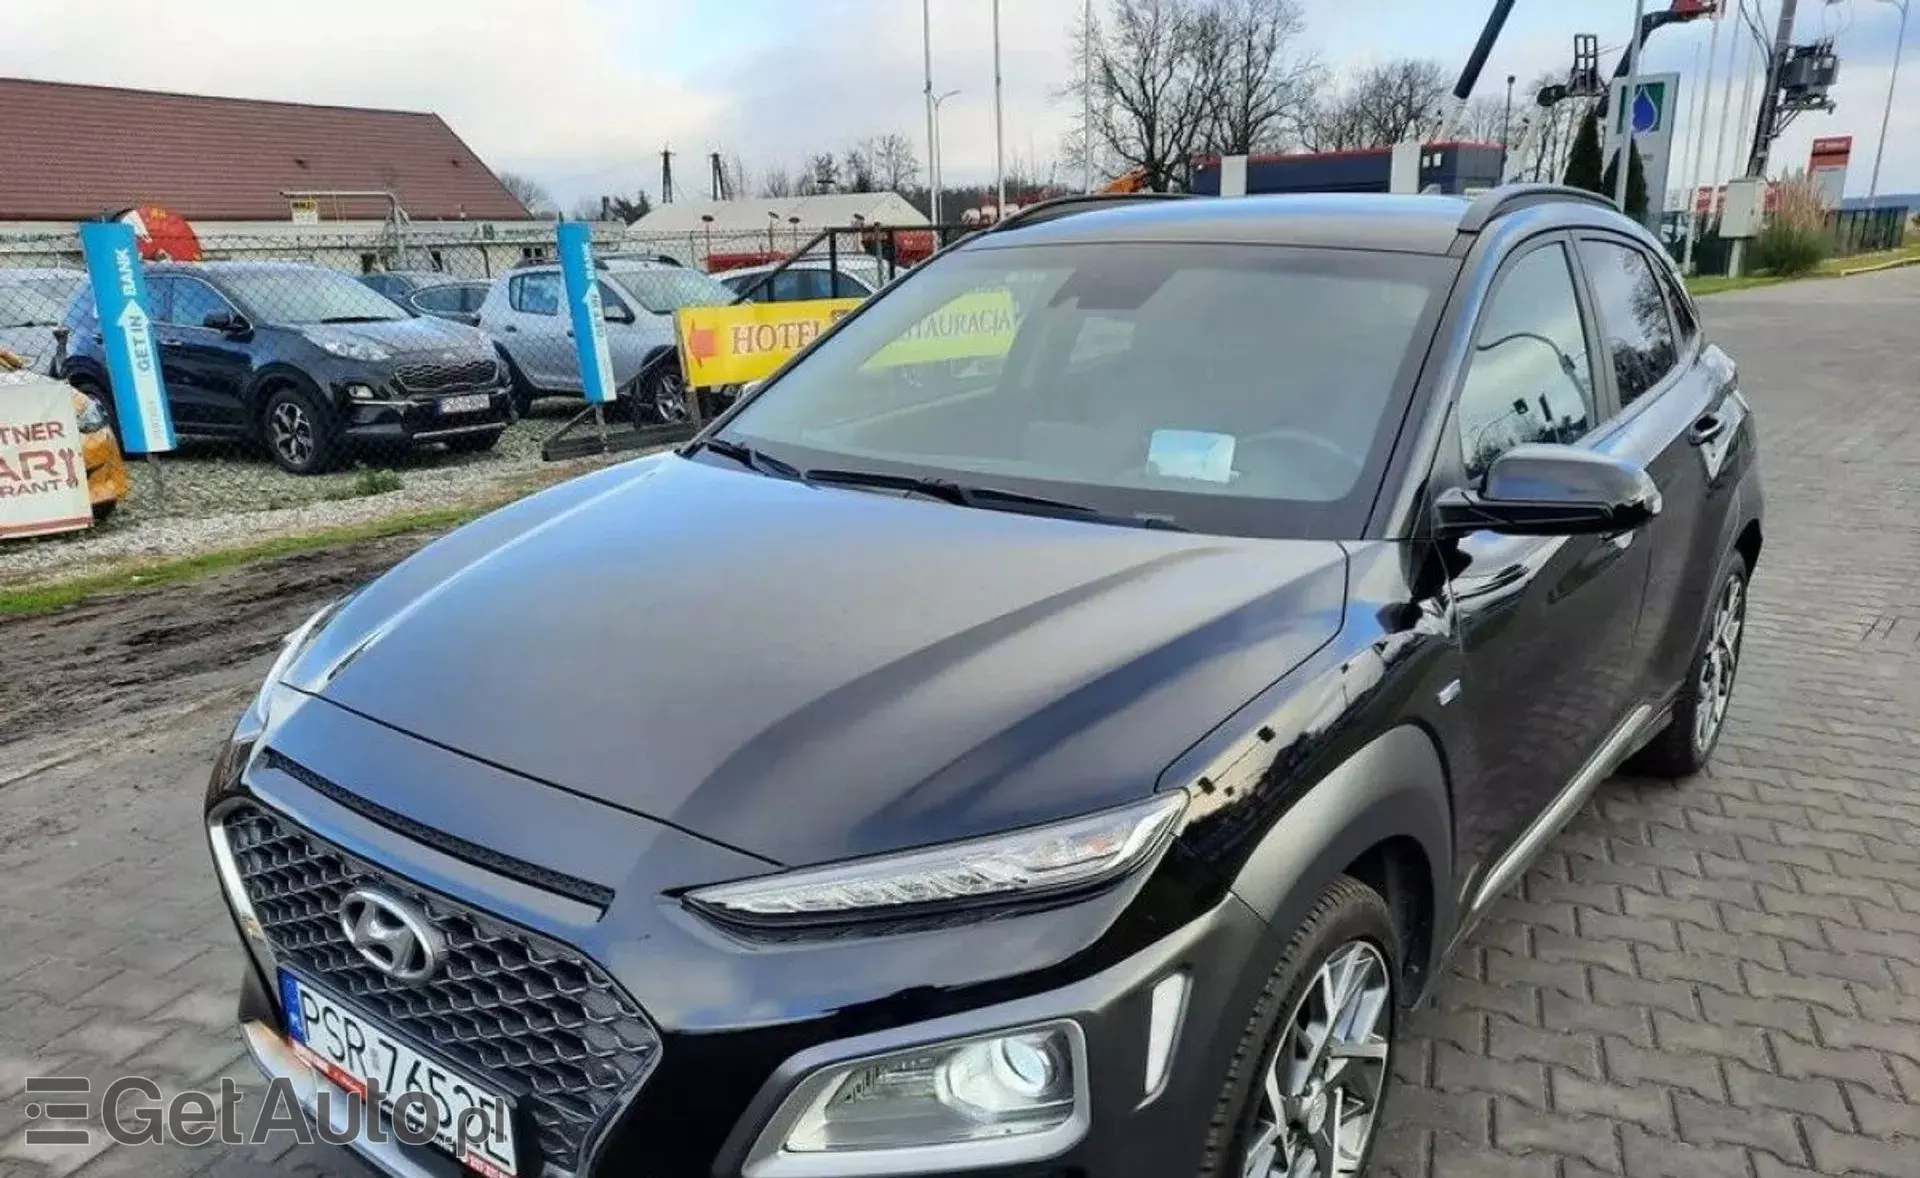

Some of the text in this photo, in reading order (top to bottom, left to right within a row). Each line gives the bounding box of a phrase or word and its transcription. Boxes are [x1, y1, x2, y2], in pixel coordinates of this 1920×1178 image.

[115, 248, 137, 297] BANK
[128, 315, 150, 372] GET IN
[302, 990, 368, 1077] PSR
